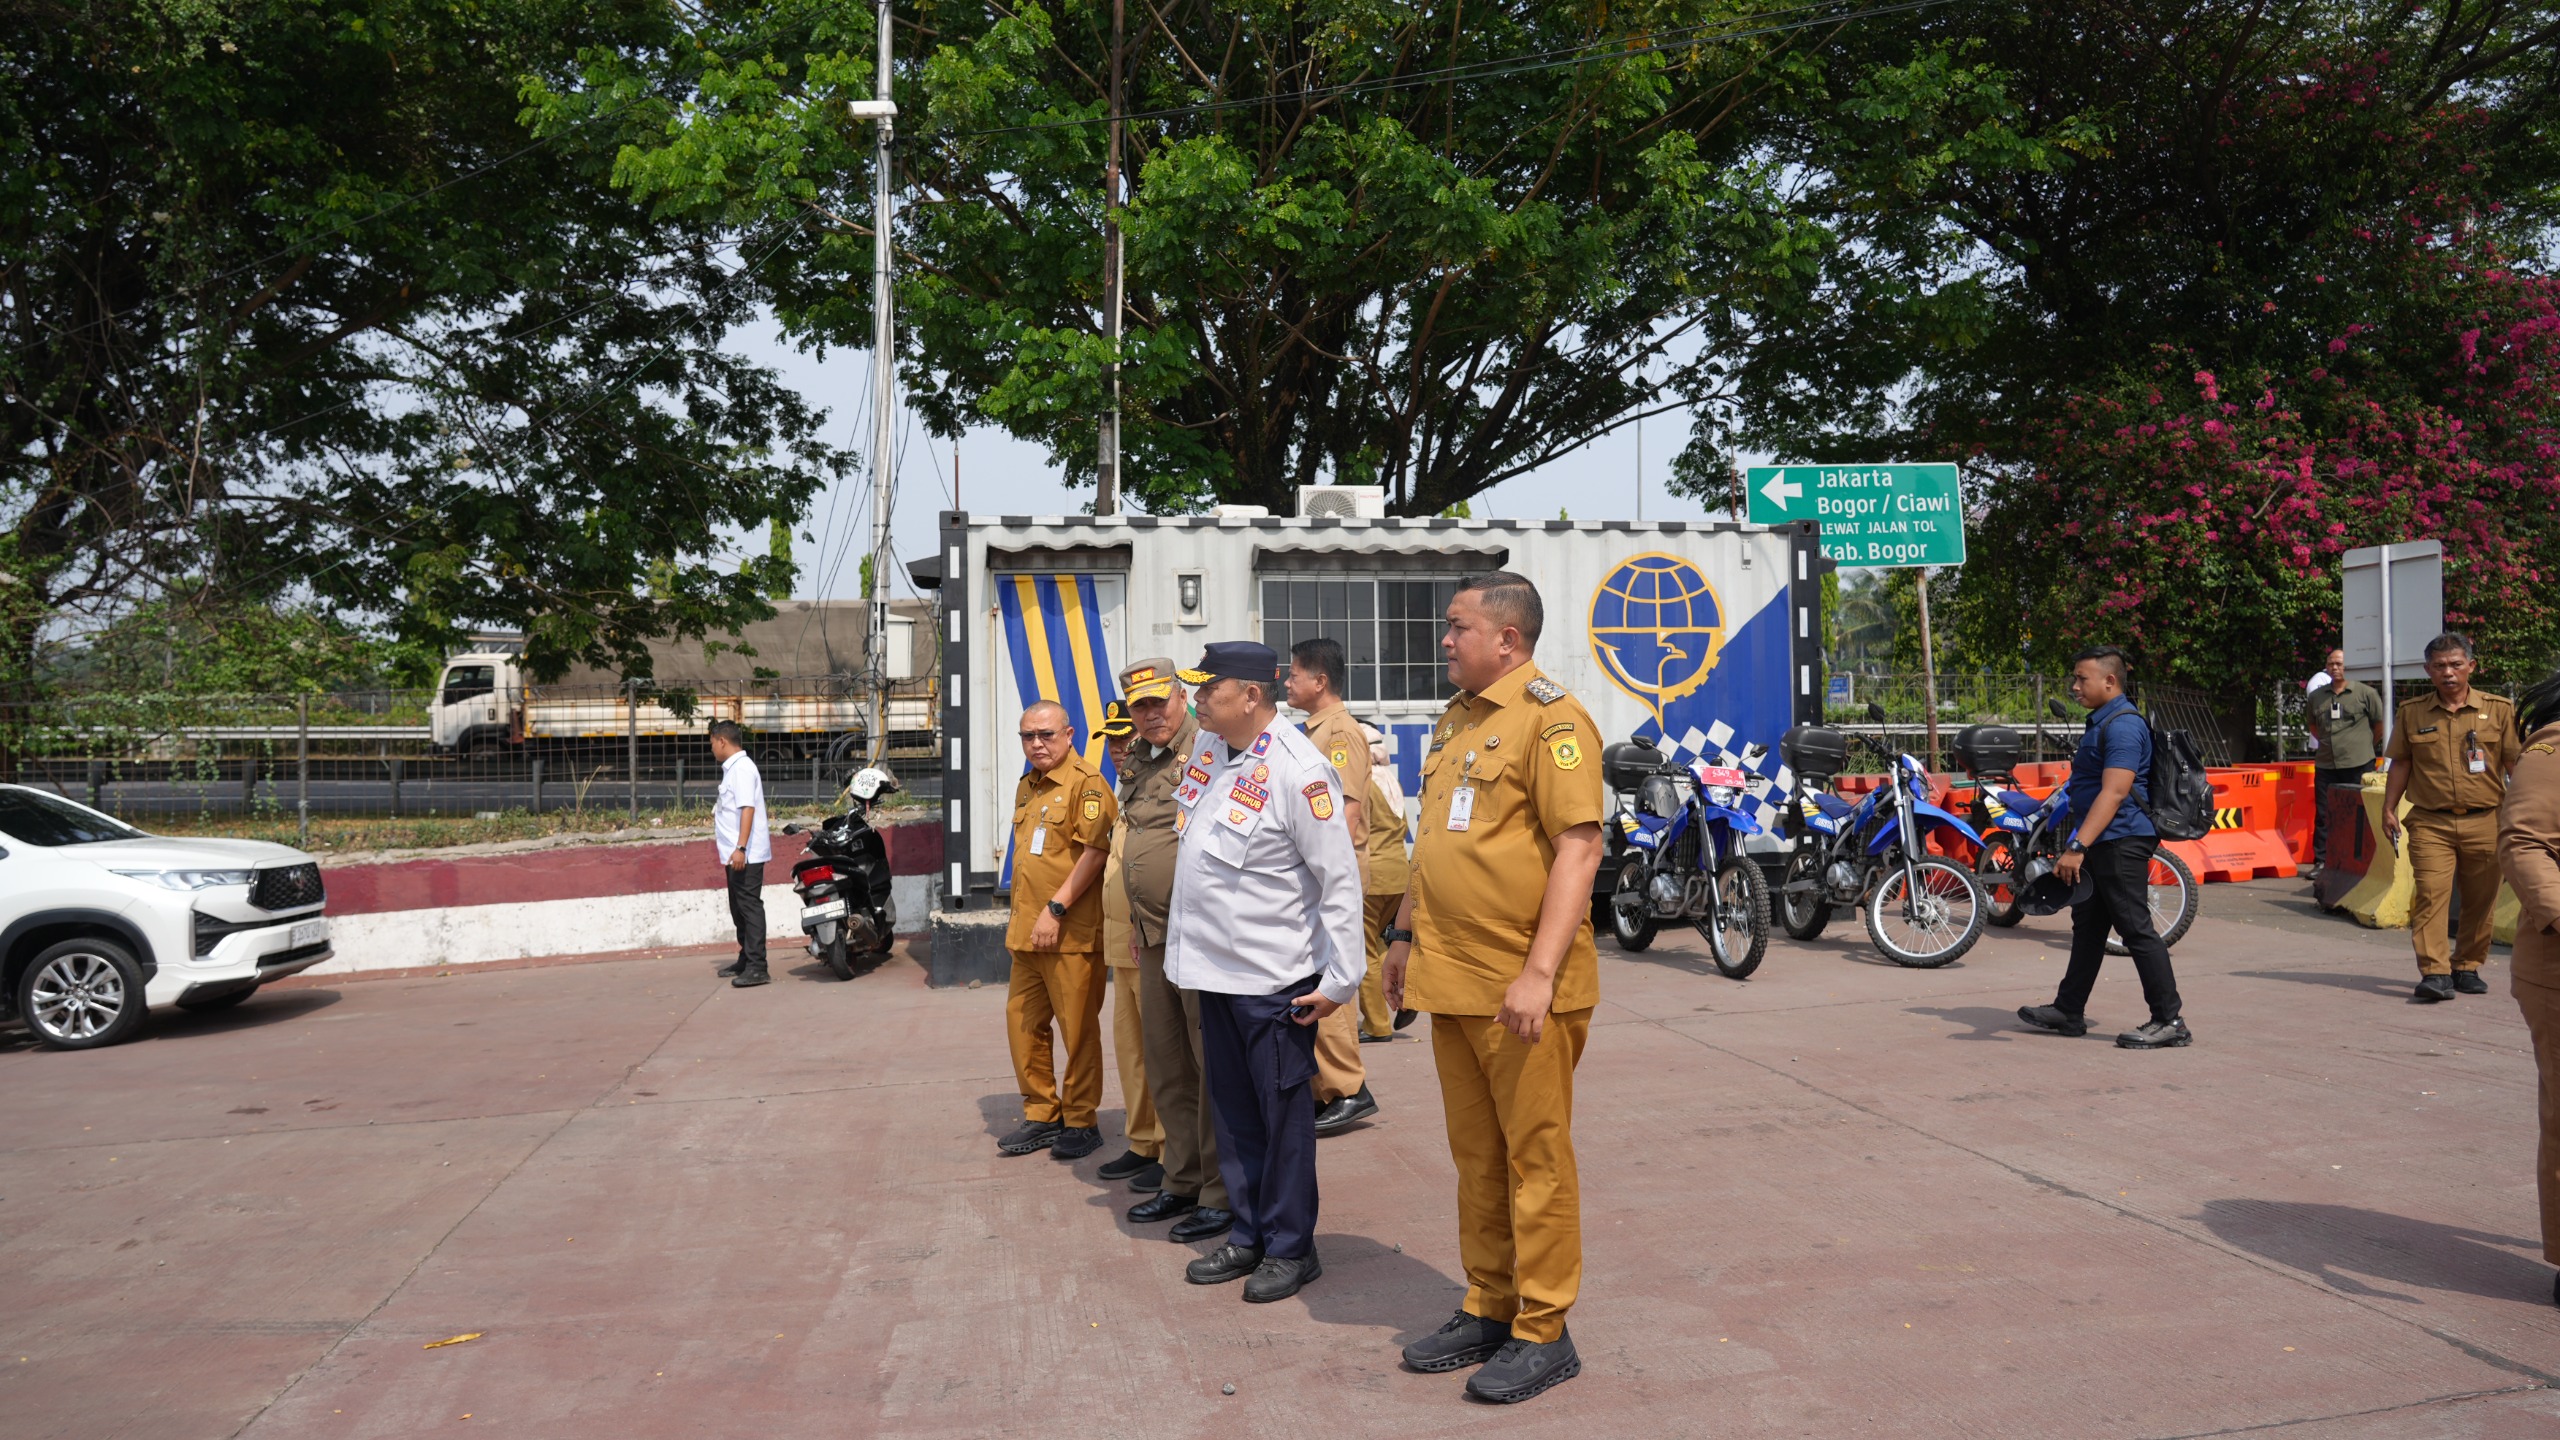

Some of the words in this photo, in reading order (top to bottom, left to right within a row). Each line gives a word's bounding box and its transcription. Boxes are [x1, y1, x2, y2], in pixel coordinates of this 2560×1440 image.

[1817, 469, 1892, 488] Jakarta
[1817, 497, 1877, 518] Bogor
[1882, 494, 1890, 514] /
[1896, 492, 1950, 512] Ciawi
[1820, 522, 1860, 535] LEWAT
[1867, 521, 1908, 534] JALAN
[1913, 520, 1937, 533] TOL
[1821, 542, 1863, 560] Kab.
[1868, 542, 1927, 563] Bogor
[1189, 767, 1208, 782] BAYU
[1232, 789, 1262, 809] DISHUB
